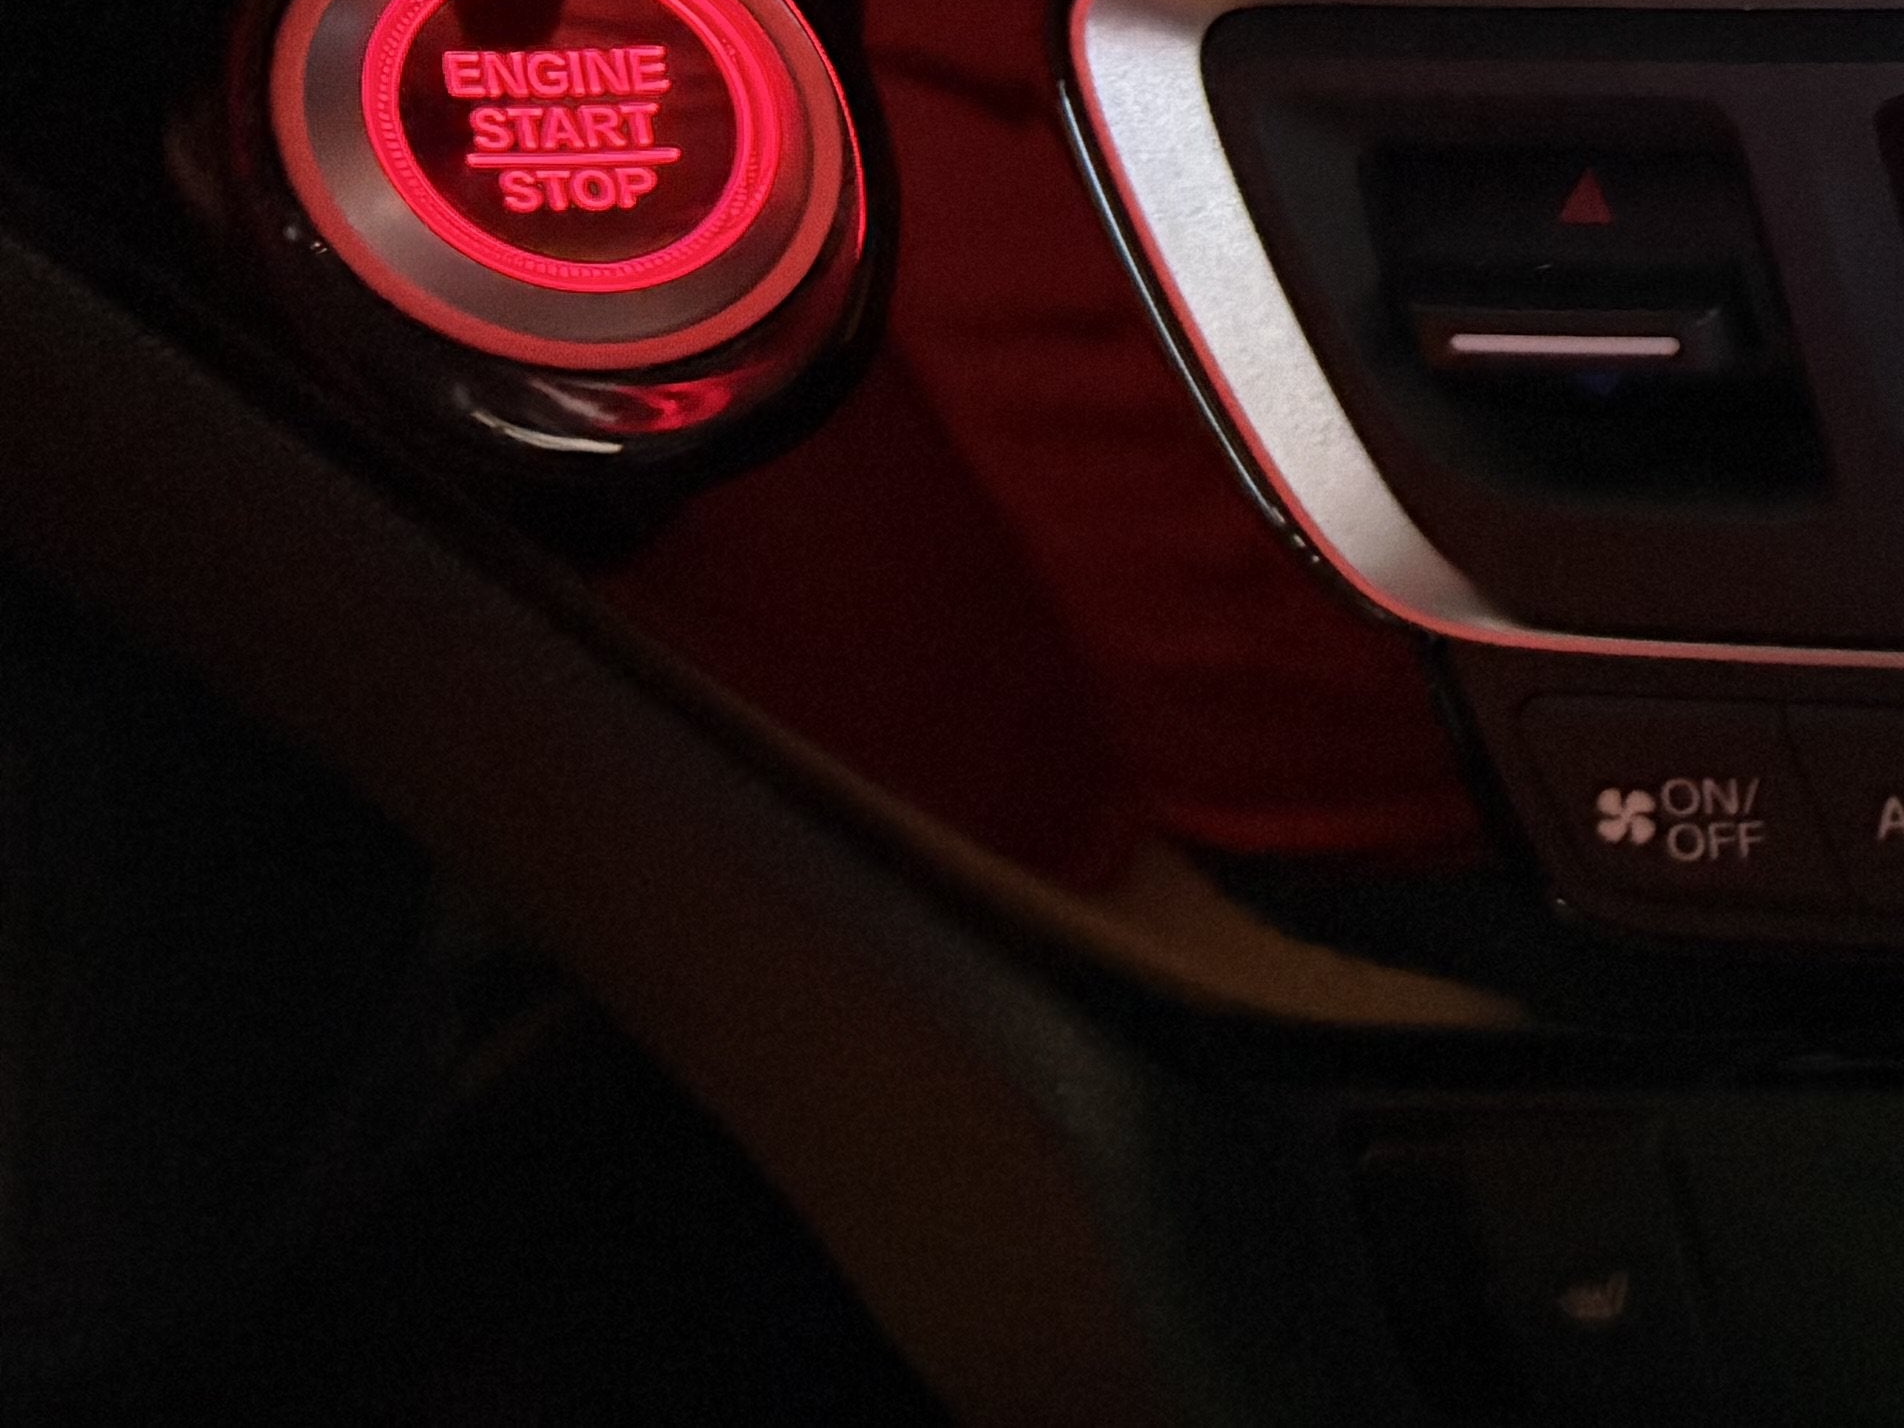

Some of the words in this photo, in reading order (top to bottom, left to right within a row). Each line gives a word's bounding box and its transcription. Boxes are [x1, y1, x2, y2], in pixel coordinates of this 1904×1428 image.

[443, 46, 670, 98] ENGINE
[470, 102, 660, 149] START
[497, 166, 658, 212] STOP
[1659, 776, 1759, 819] ON/
[1665, 820, 1762, 863] OFF
